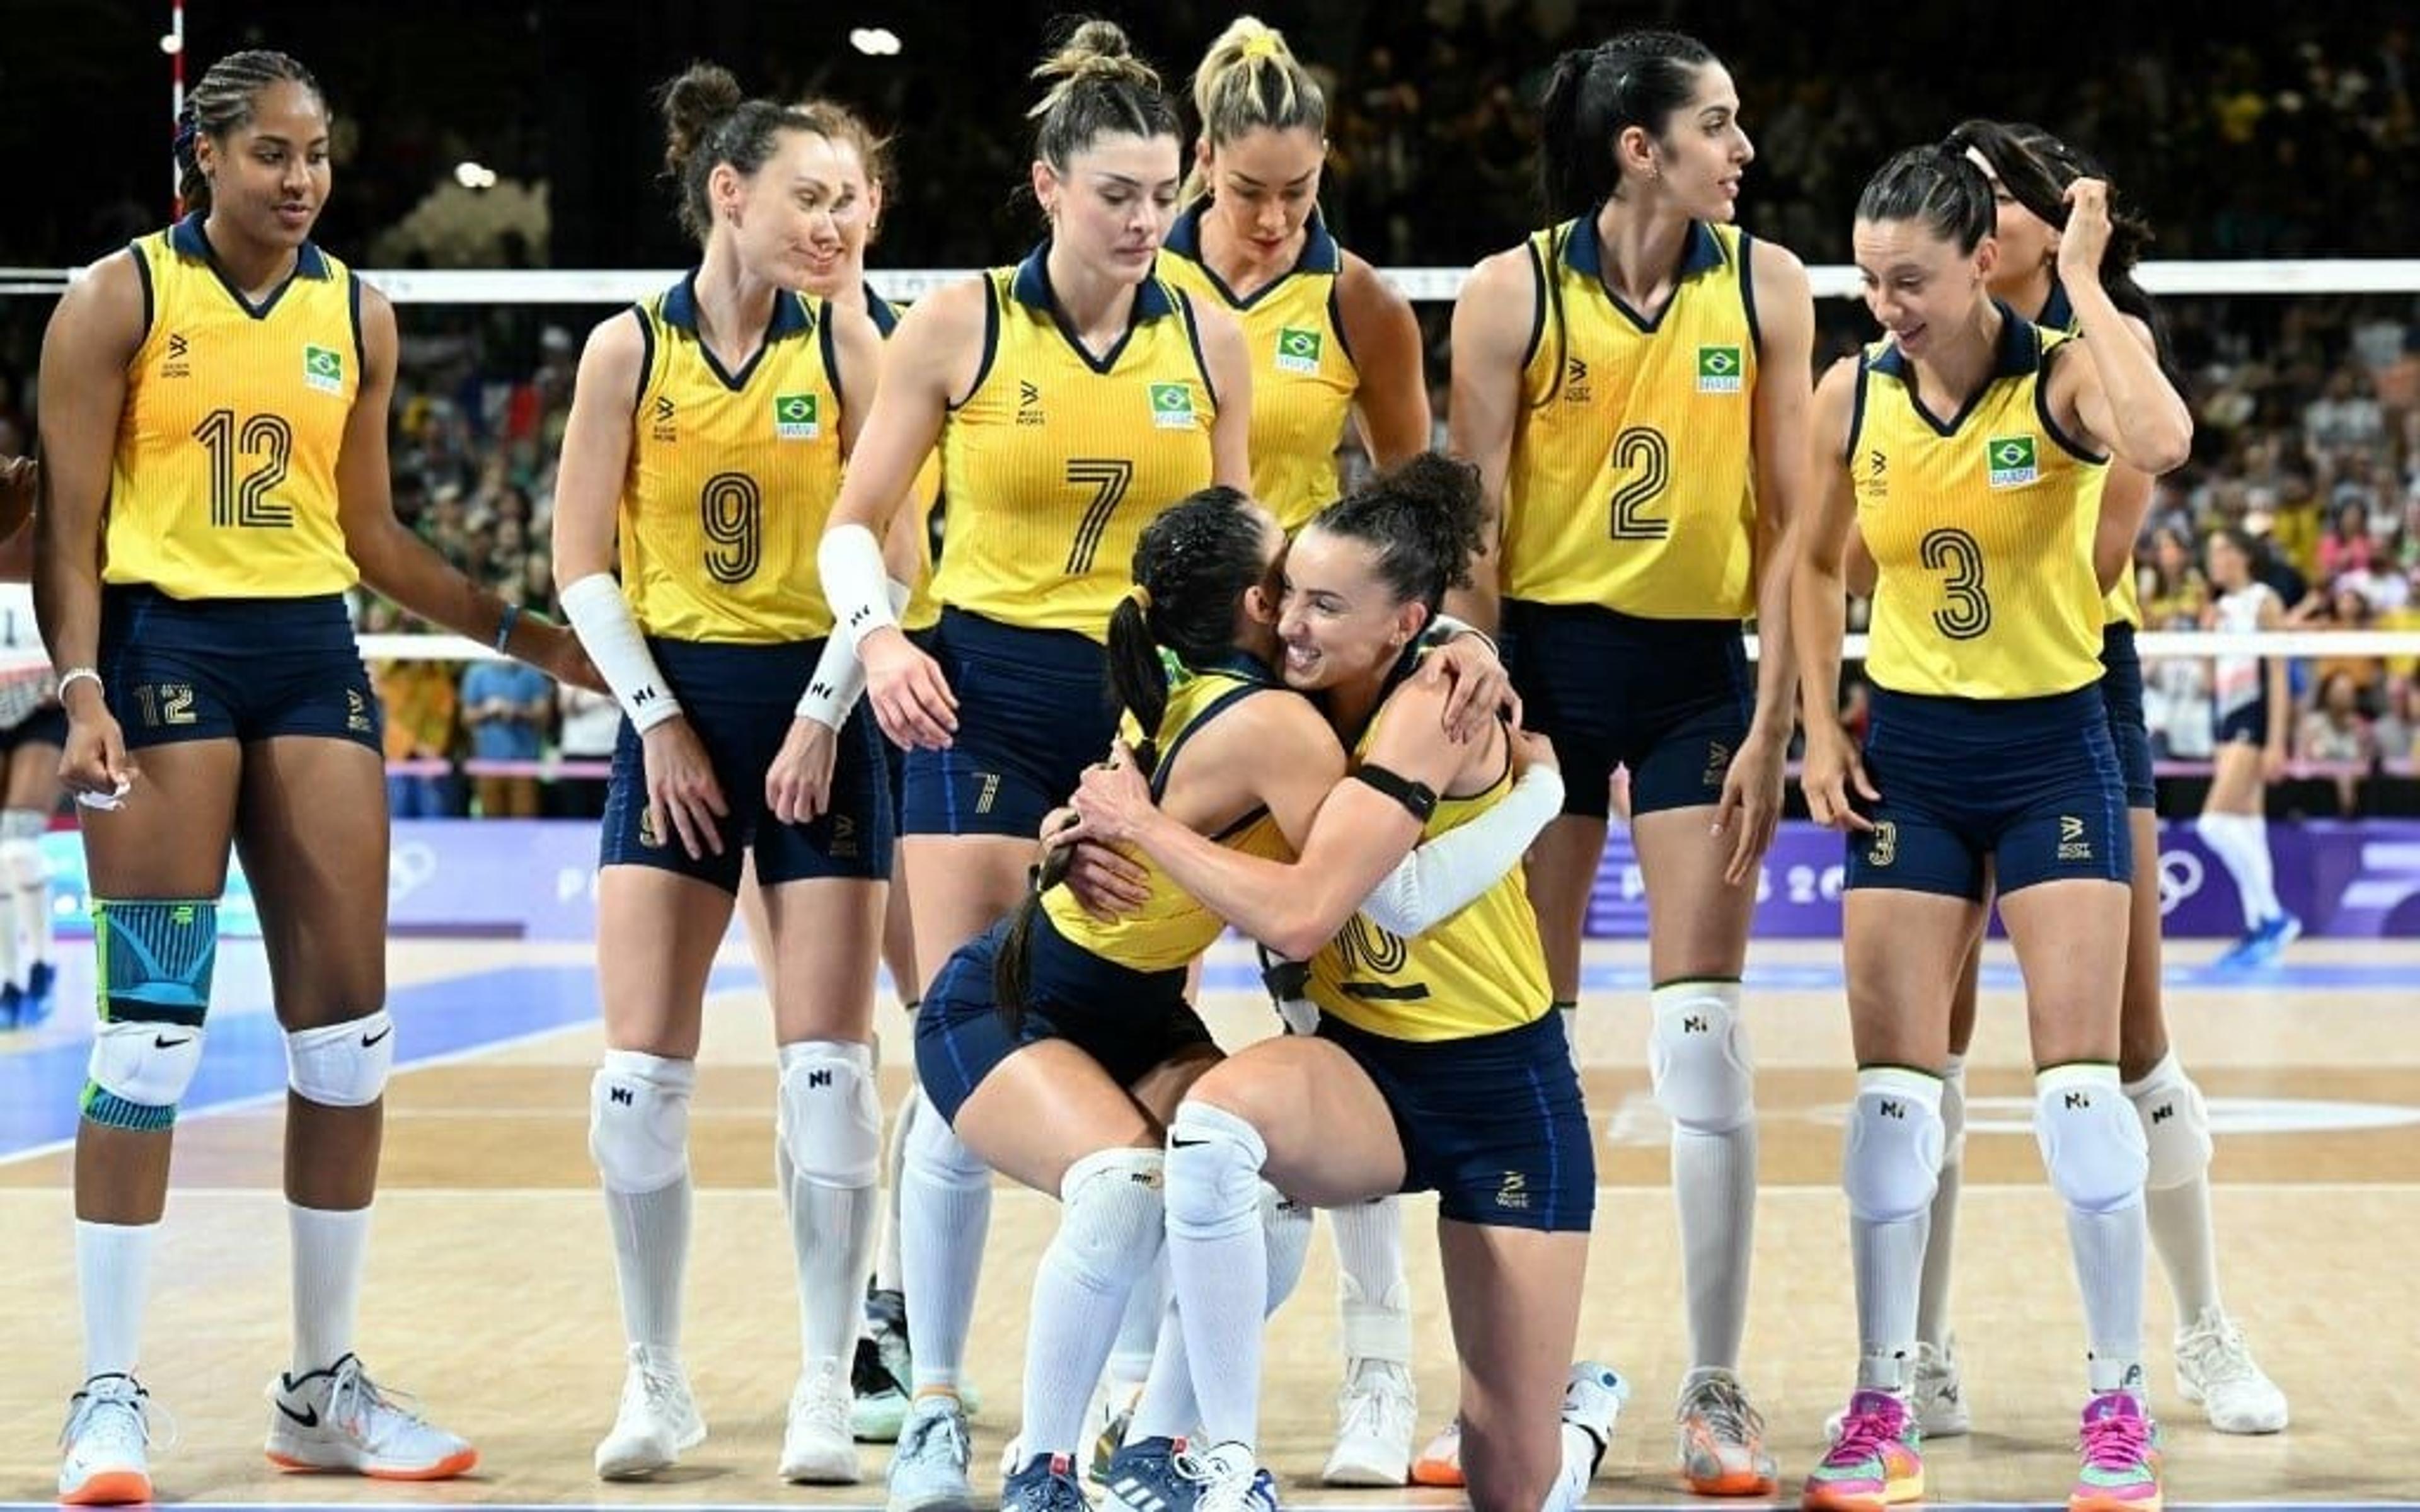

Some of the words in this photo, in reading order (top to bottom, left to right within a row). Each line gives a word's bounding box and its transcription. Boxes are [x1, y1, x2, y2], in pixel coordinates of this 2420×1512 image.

[193, 409, 293, 529] 12
[1067, 460, 1133, 575] 7
[1611, 427, 1669, 541] 2
[701, 472, 761, 584] 9
[1920, 527, 1991, 641] 3
[134, 684, 197, 726] 12
[971, 772, 1000, 813] 7
[1869, 822, 1896, 866] 3
